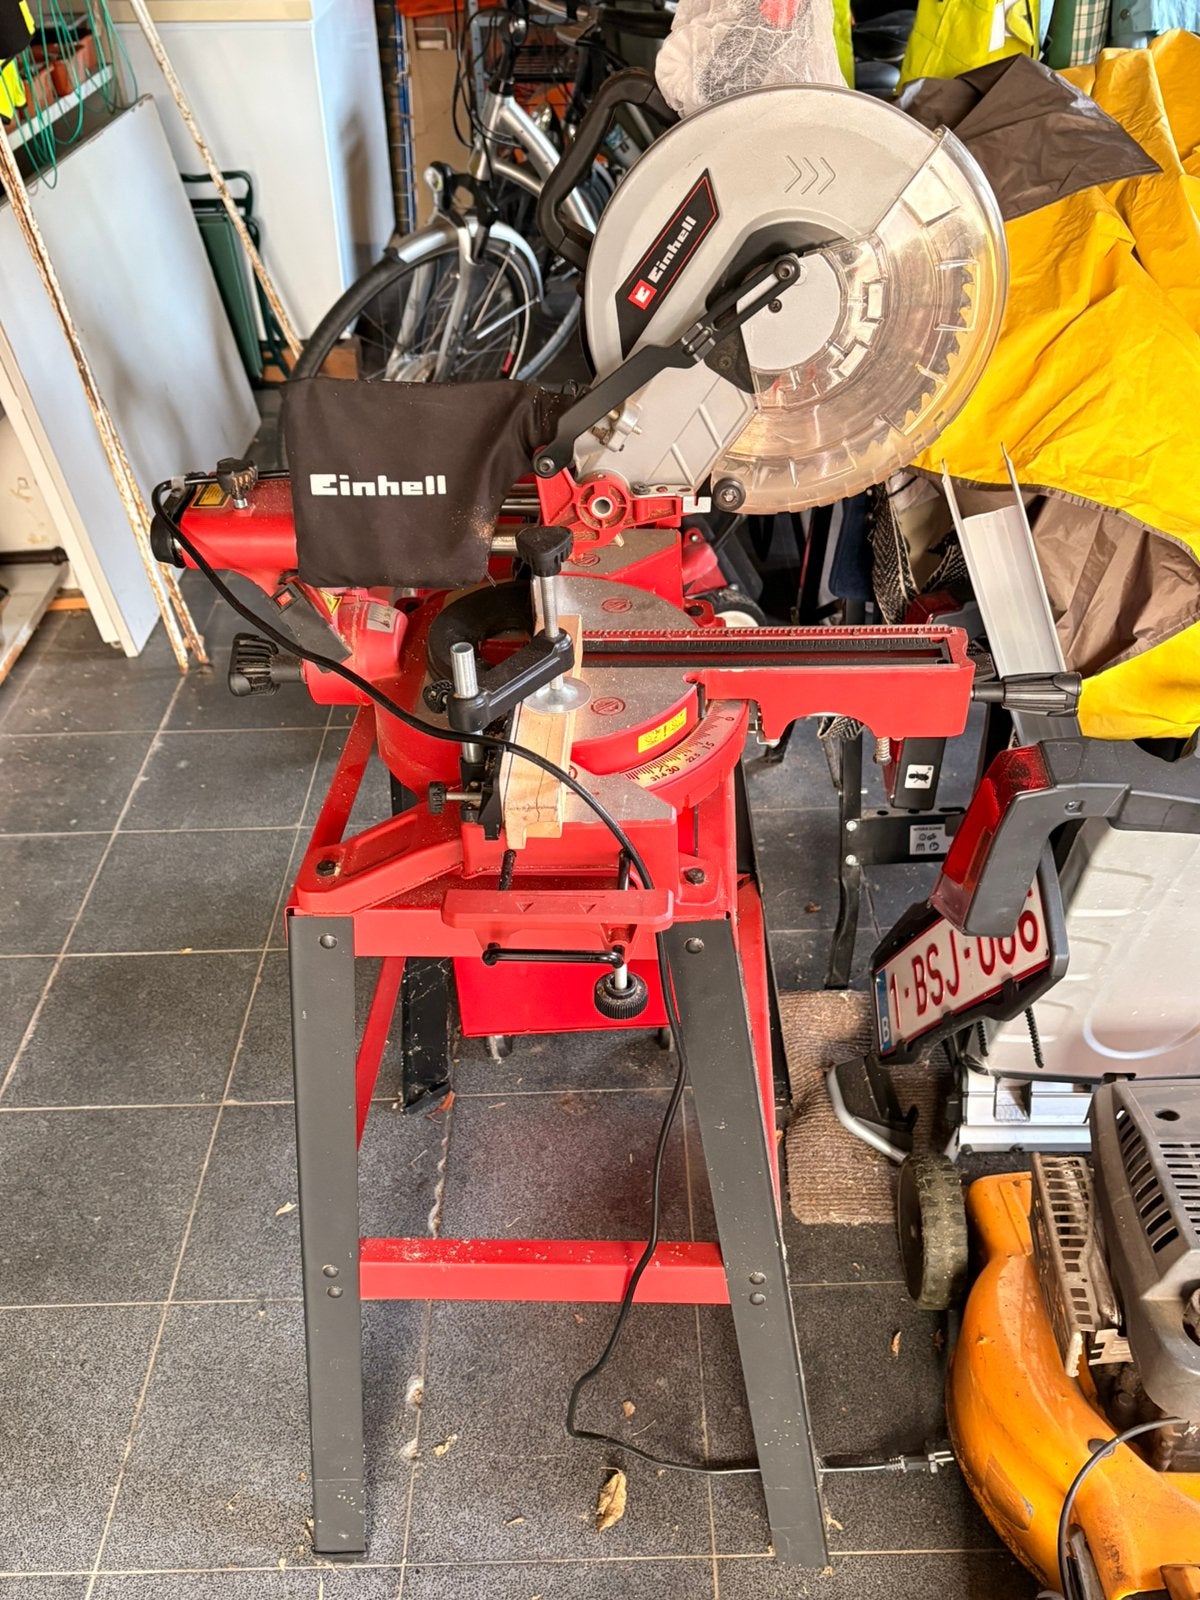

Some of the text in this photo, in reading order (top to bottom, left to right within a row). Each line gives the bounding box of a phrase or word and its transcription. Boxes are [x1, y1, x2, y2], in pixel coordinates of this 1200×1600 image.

[648, 215, 697, 284] Einhell
[310, 473, 447, 496] Einhell
[702, 741, 715, 750] 15
[664, 765, 680, 775] 30
[881, 1016, 890, 1042] B
